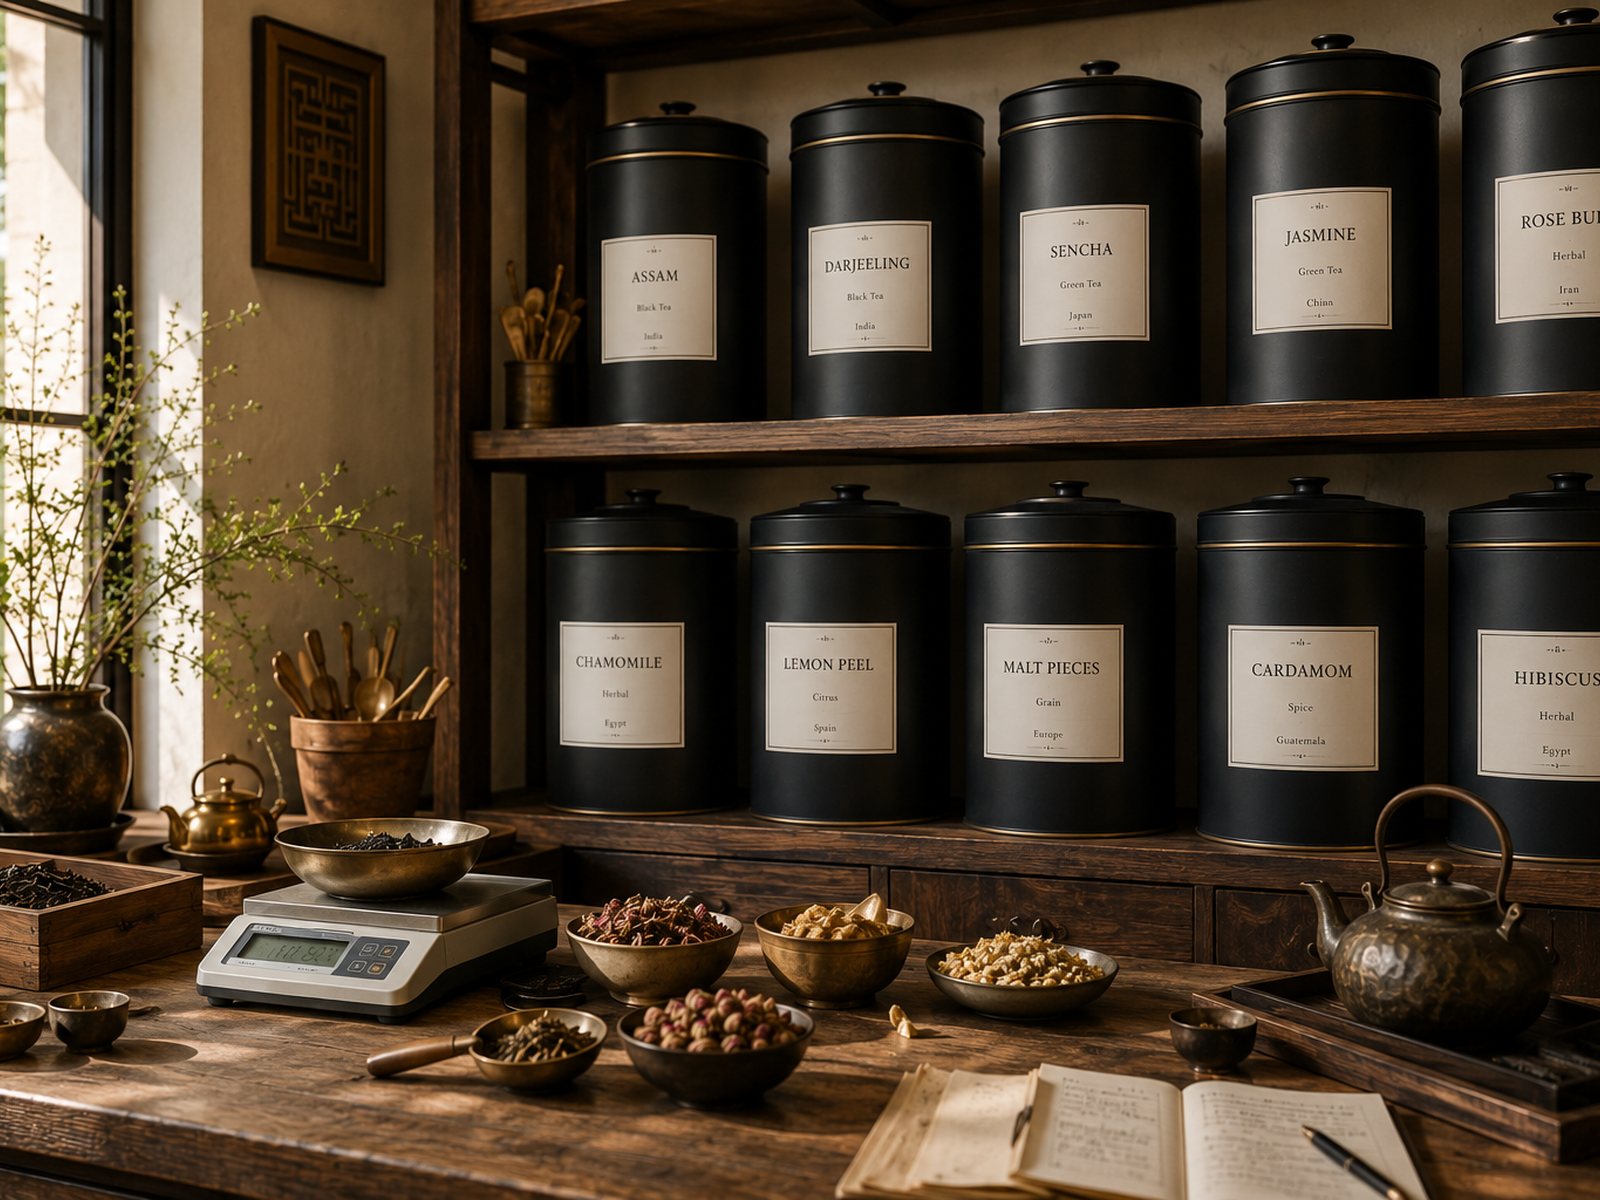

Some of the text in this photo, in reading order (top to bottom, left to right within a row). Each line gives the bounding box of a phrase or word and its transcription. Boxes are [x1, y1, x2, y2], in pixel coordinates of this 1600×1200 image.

[1521, 210, 1600, 229] ROSE BU
[1285, 227, 1357, 246] JASMINE
[1050, 242, 1113, 259] SENCHA
[1552, 249, 1586, 262] Herbal
[824, 257, 910, 274] DARJEELING
[1297, 265, 1343, 277] Green Tea
[631, 269, 679, 284] ASSAM
[1059, 279, 1102, 291] Green Tea
[1559, 285, 1580, 295] Iran
[847, 290, 884, 302] Black Tea
[636, 300, 672, 312] Black Tea
[1068, 310, 1093, 322] Japan
[855, 320, 876, 331] India
[643, 330, 663, 341] India
[575, 655, 663, 669] CHAMOMILE
[783, 656, 875, 672] LEMON PEEL
[1003, 660, 1101, 677] MALT PIECES
[1251, 662, 1353, 680] CARDAMOM
[1515, 670, 1600, 687] HIBISCUS
[602, 688, 629, 699] Herbal
[812, 691, 839, 703] Citrus
[1035, 696, 1061, 708] Grain
[1287, 702, 1314, 715] Spice
[1539, 710, 1575, 722] Herbal
[604, 718, 627, 730] Egypt
[813, 722, 837, 735] Spain
[1033, 729, 1064, 742] Europe
[1276, 734, 1326, 746] Guatemala
[1542, 744, 1571, 758] Egypt
